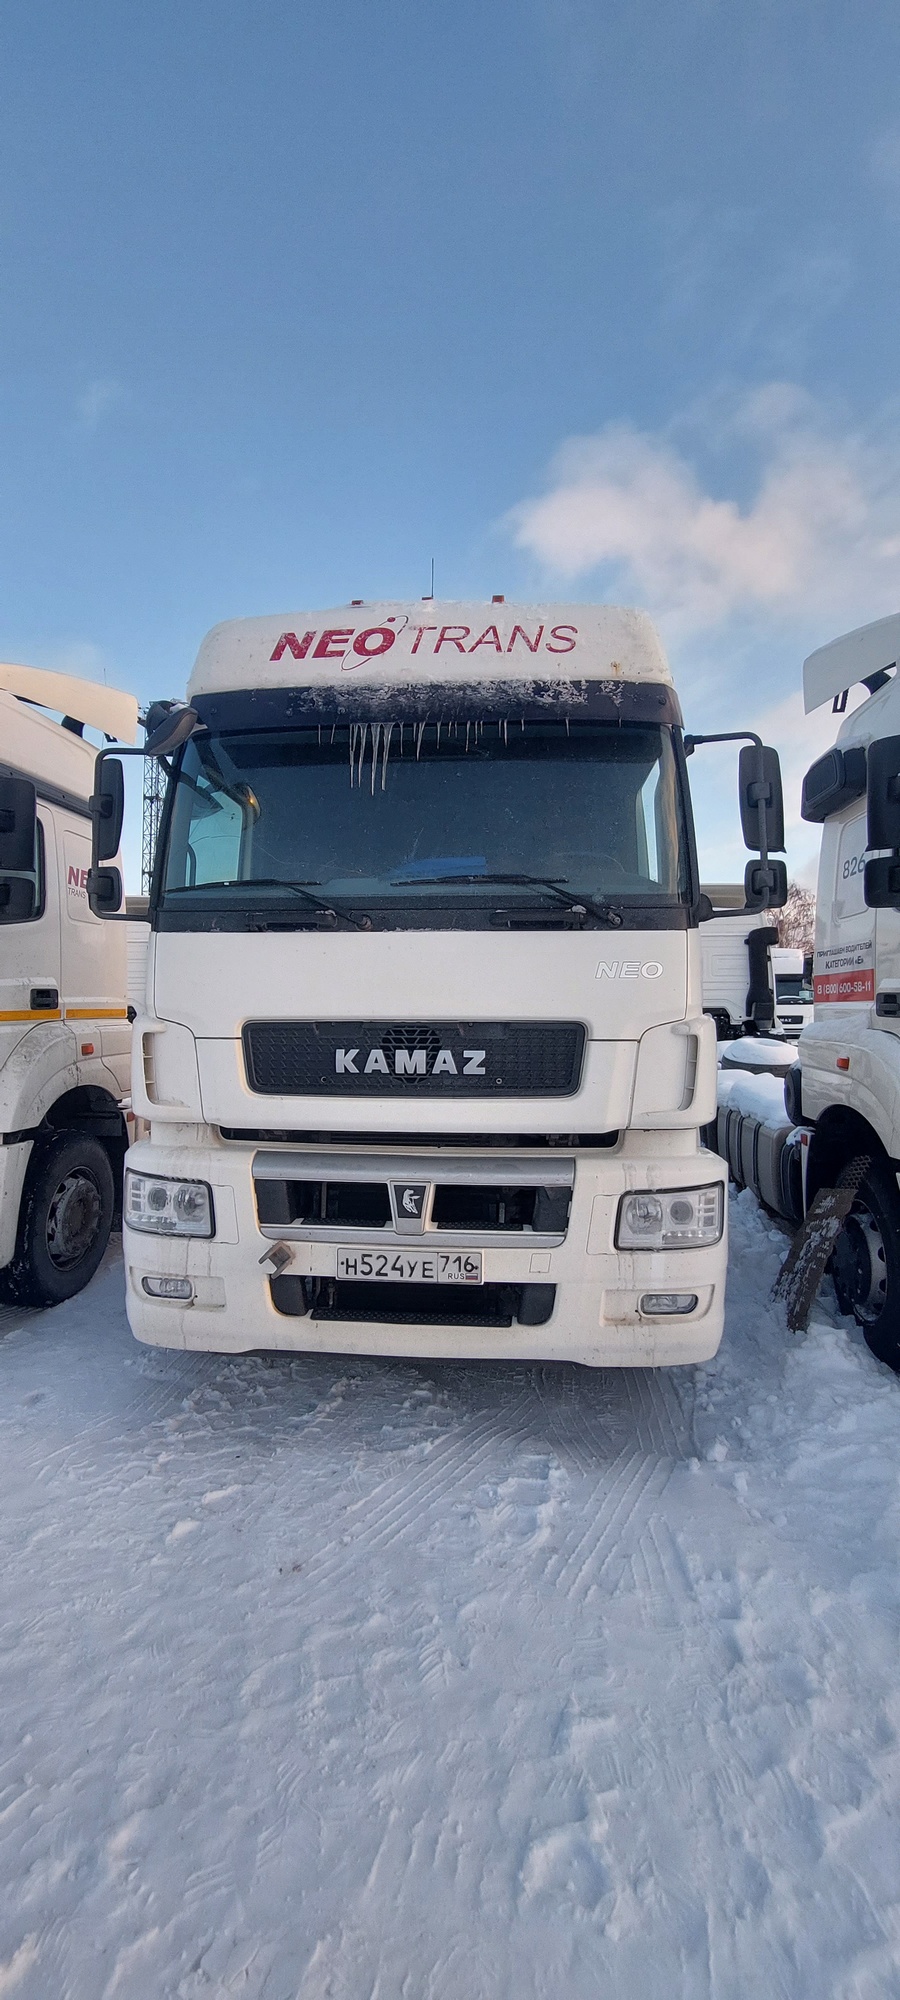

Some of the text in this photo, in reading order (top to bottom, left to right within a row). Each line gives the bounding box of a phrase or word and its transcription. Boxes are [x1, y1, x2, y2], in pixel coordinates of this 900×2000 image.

[68, 866, 88, 888] NE
[68, 887, 86, 898] TRANS
[595, 961, 664, 979] NEO
[825, 957, 854, 969] КАТЕГОРИИ
[335, 1048, 486, 1075] KAMAZ
[440, 1255, 475, 1273] 716
[447, 1272, 465, 1280] RUS
